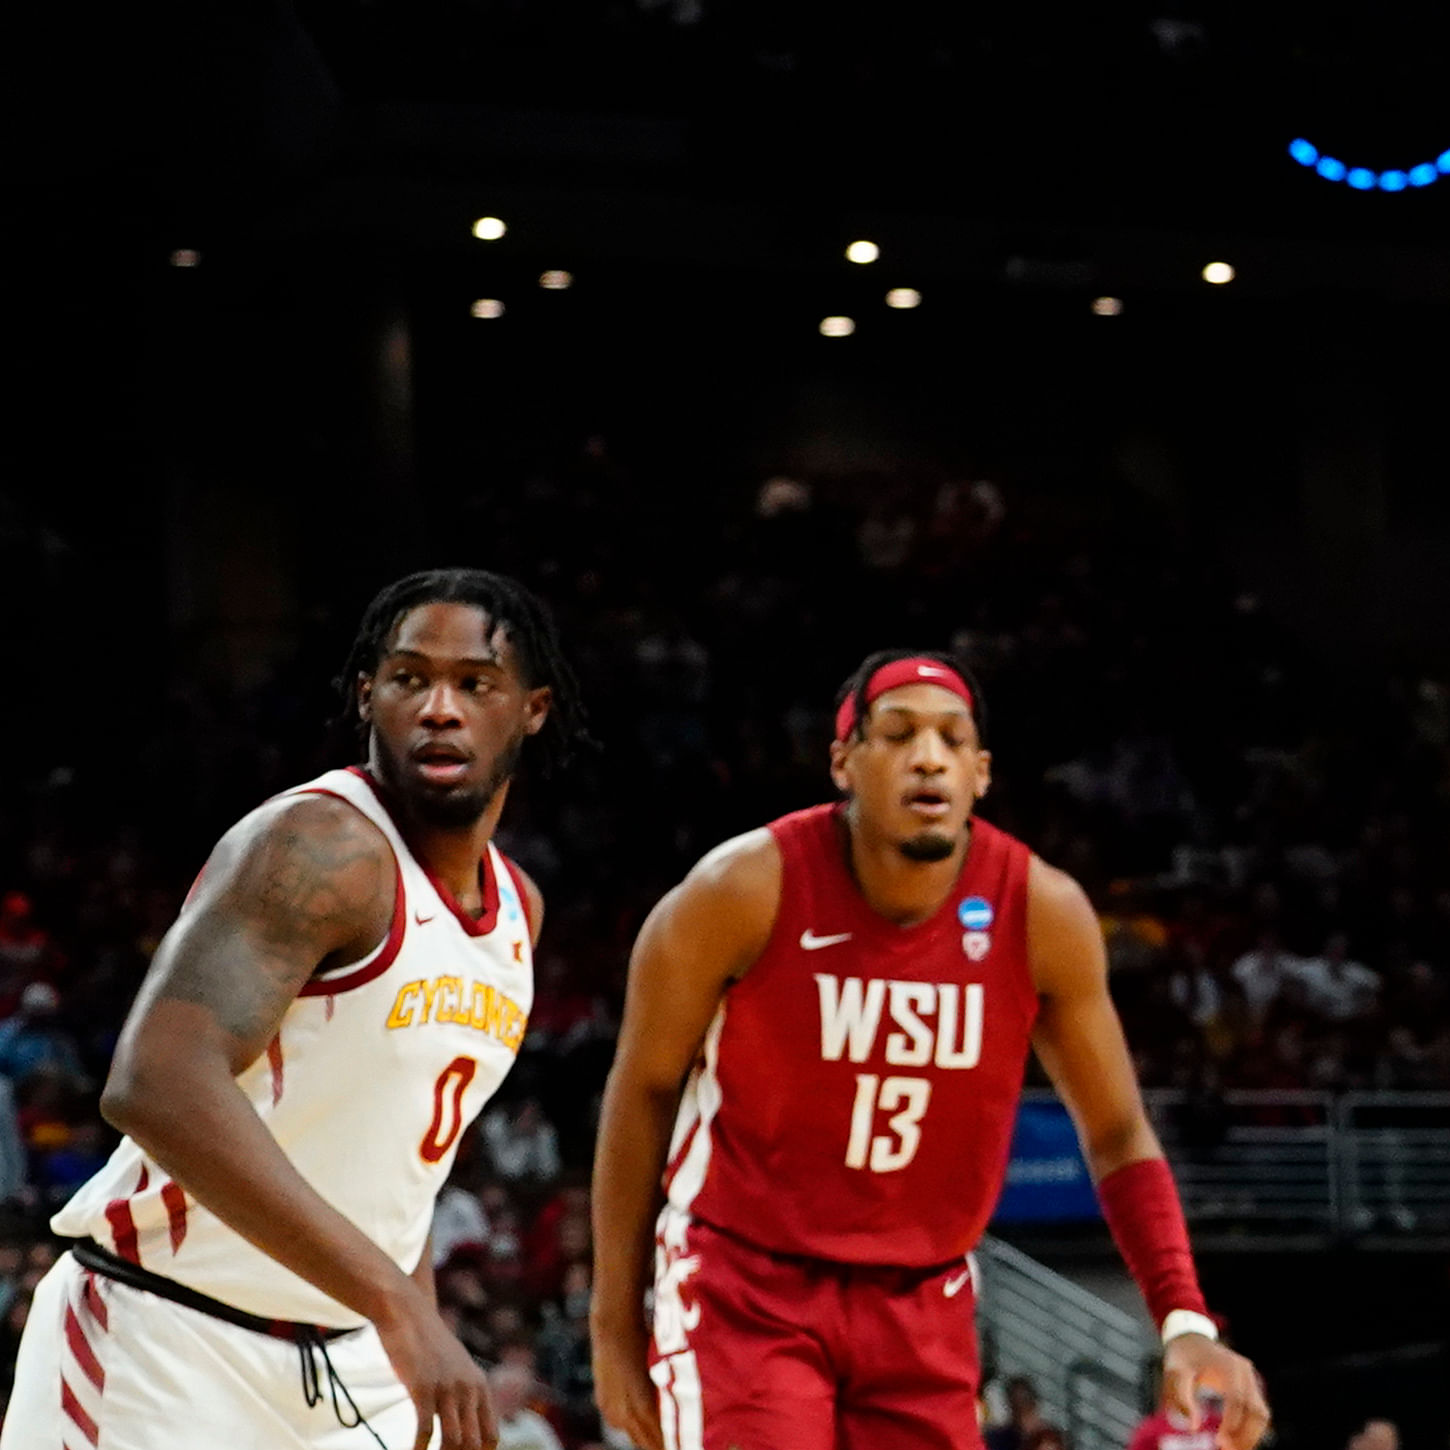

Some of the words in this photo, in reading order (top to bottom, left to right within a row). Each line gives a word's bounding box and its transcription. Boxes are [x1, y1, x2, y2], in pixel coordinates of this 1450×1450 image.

[813, 972, 985, 1070] WSU
[418, 1054, 477, 1164] 0
[844, 1073, 933, 1174] 13
